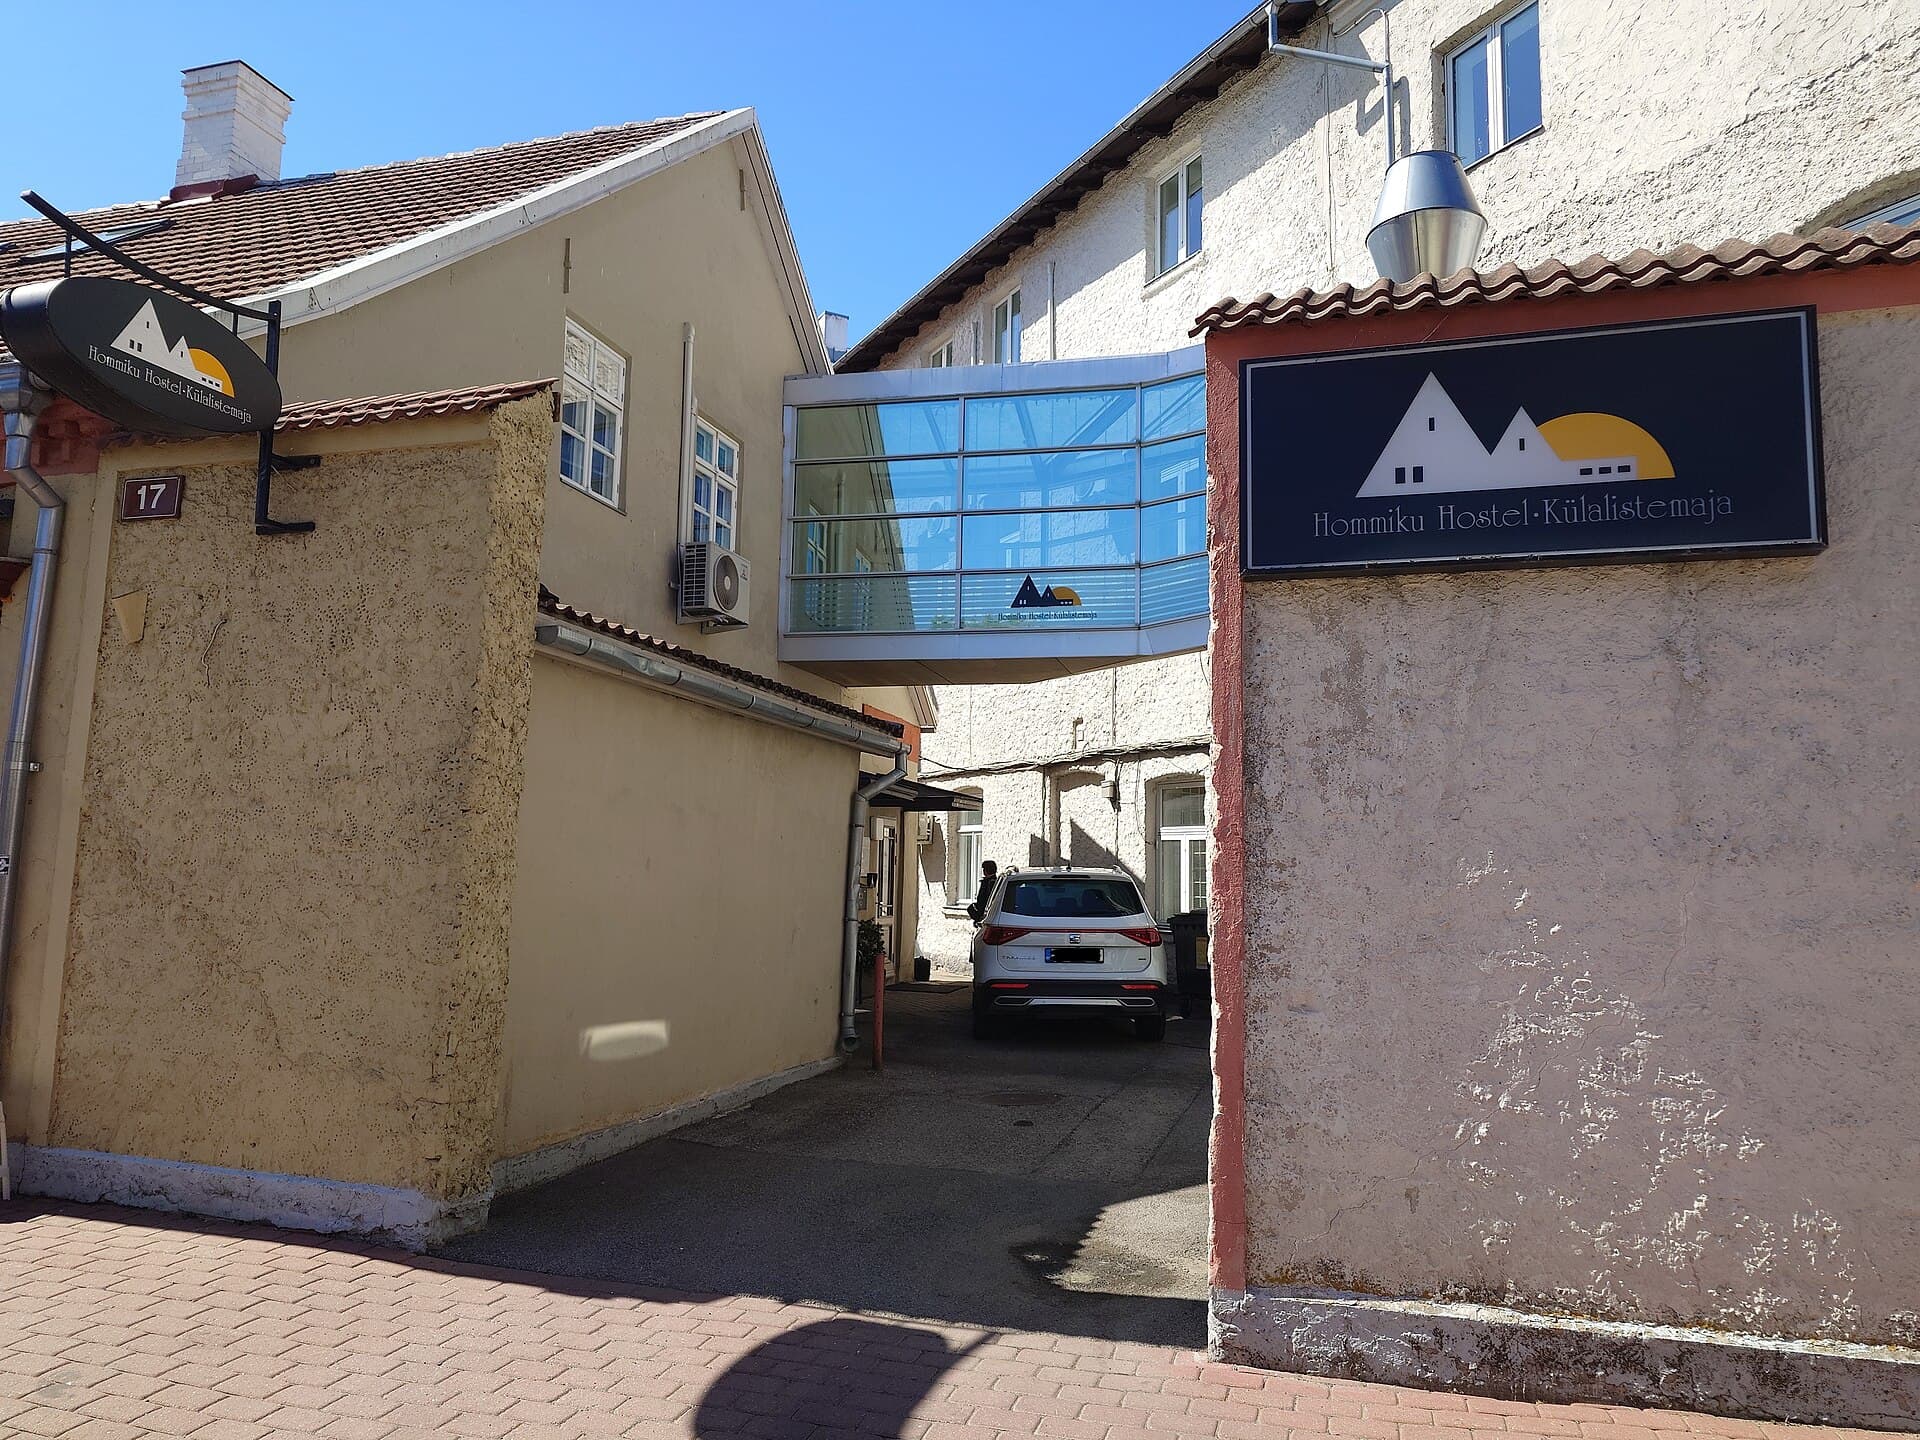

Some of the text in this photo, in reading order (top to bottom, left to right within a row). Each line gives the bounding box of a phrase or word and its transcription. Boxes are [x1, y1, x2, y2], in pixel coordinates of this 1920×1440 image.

[88, 345, 140, 379] Hommiku
[137, 483, 166, 510] 17
[1313, 504, 1425, 537] Hommiku
